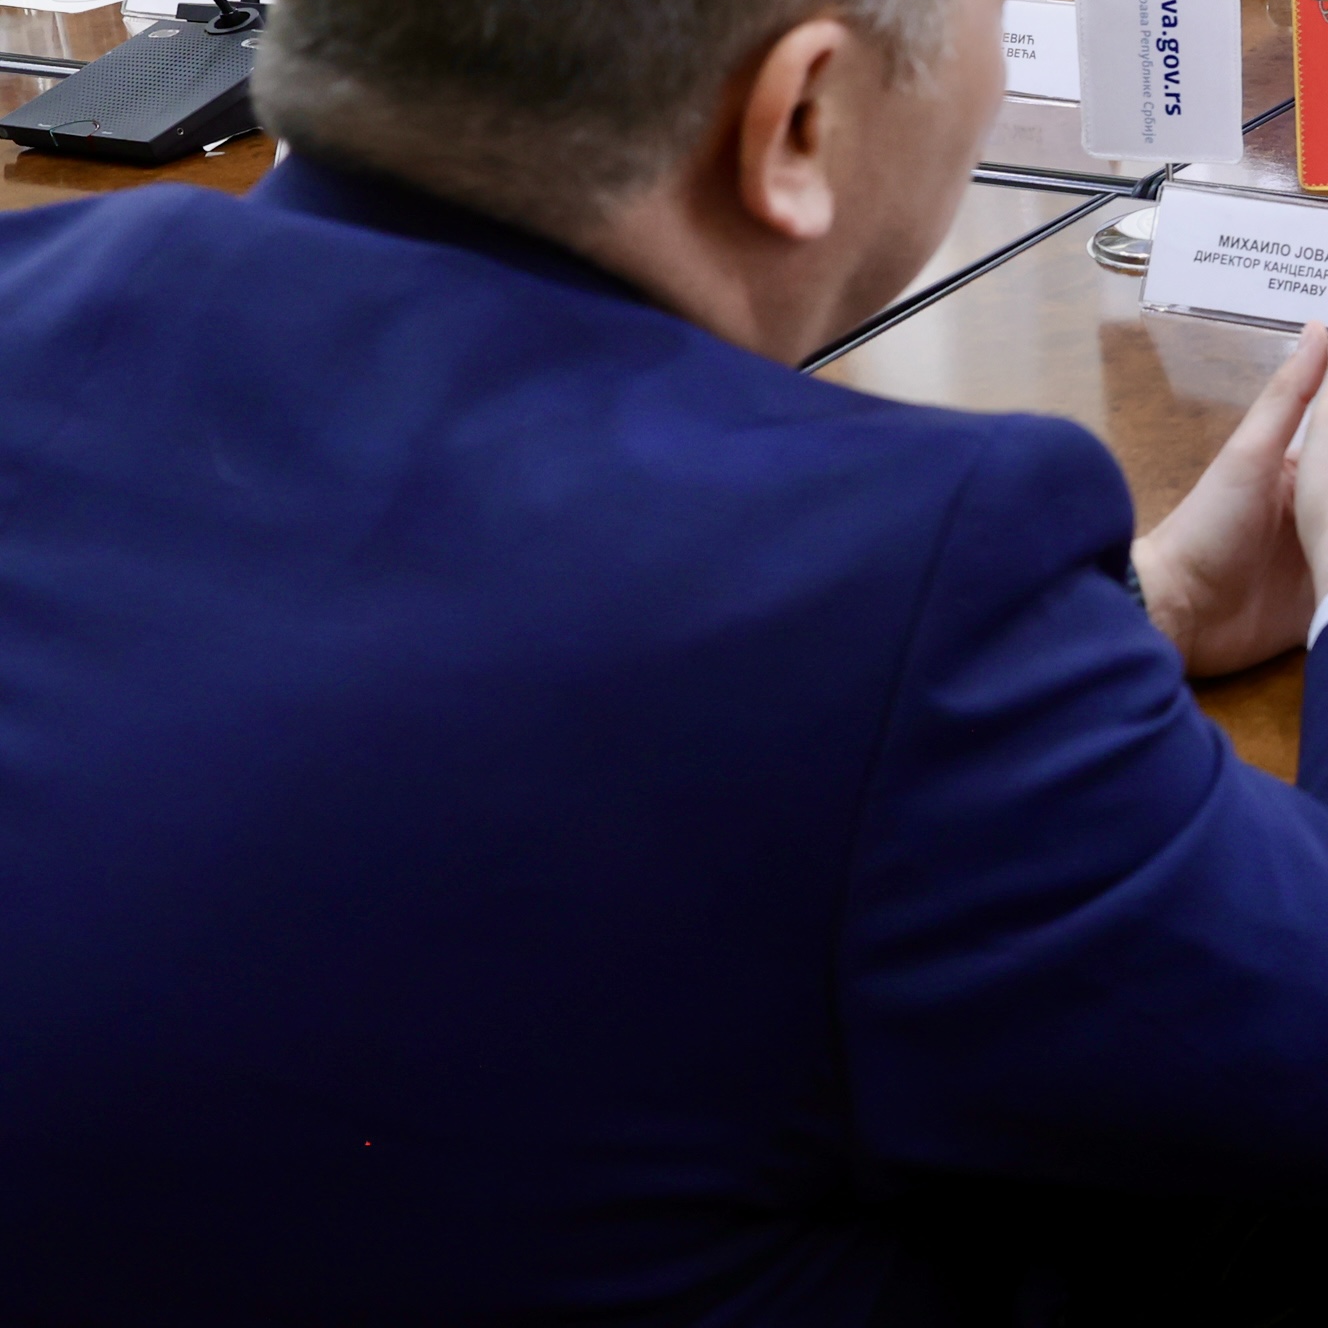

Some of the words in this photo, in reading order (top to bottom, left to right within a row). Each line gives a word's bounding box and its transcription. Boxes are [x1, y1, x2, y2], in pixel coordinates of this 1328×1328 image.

[1006, 47, 1037, 60] ВЕЋА
[1138, 30, 1154, 99] Републике
[1141, 101, 1157, 145] Србије
[1218, 234, 1292, 258] МИХАИЛО
[1193, 250, 1262, 270] ДИРЕКТОР
[1268, 278, 1328, 297] ЕУПРАВУ
